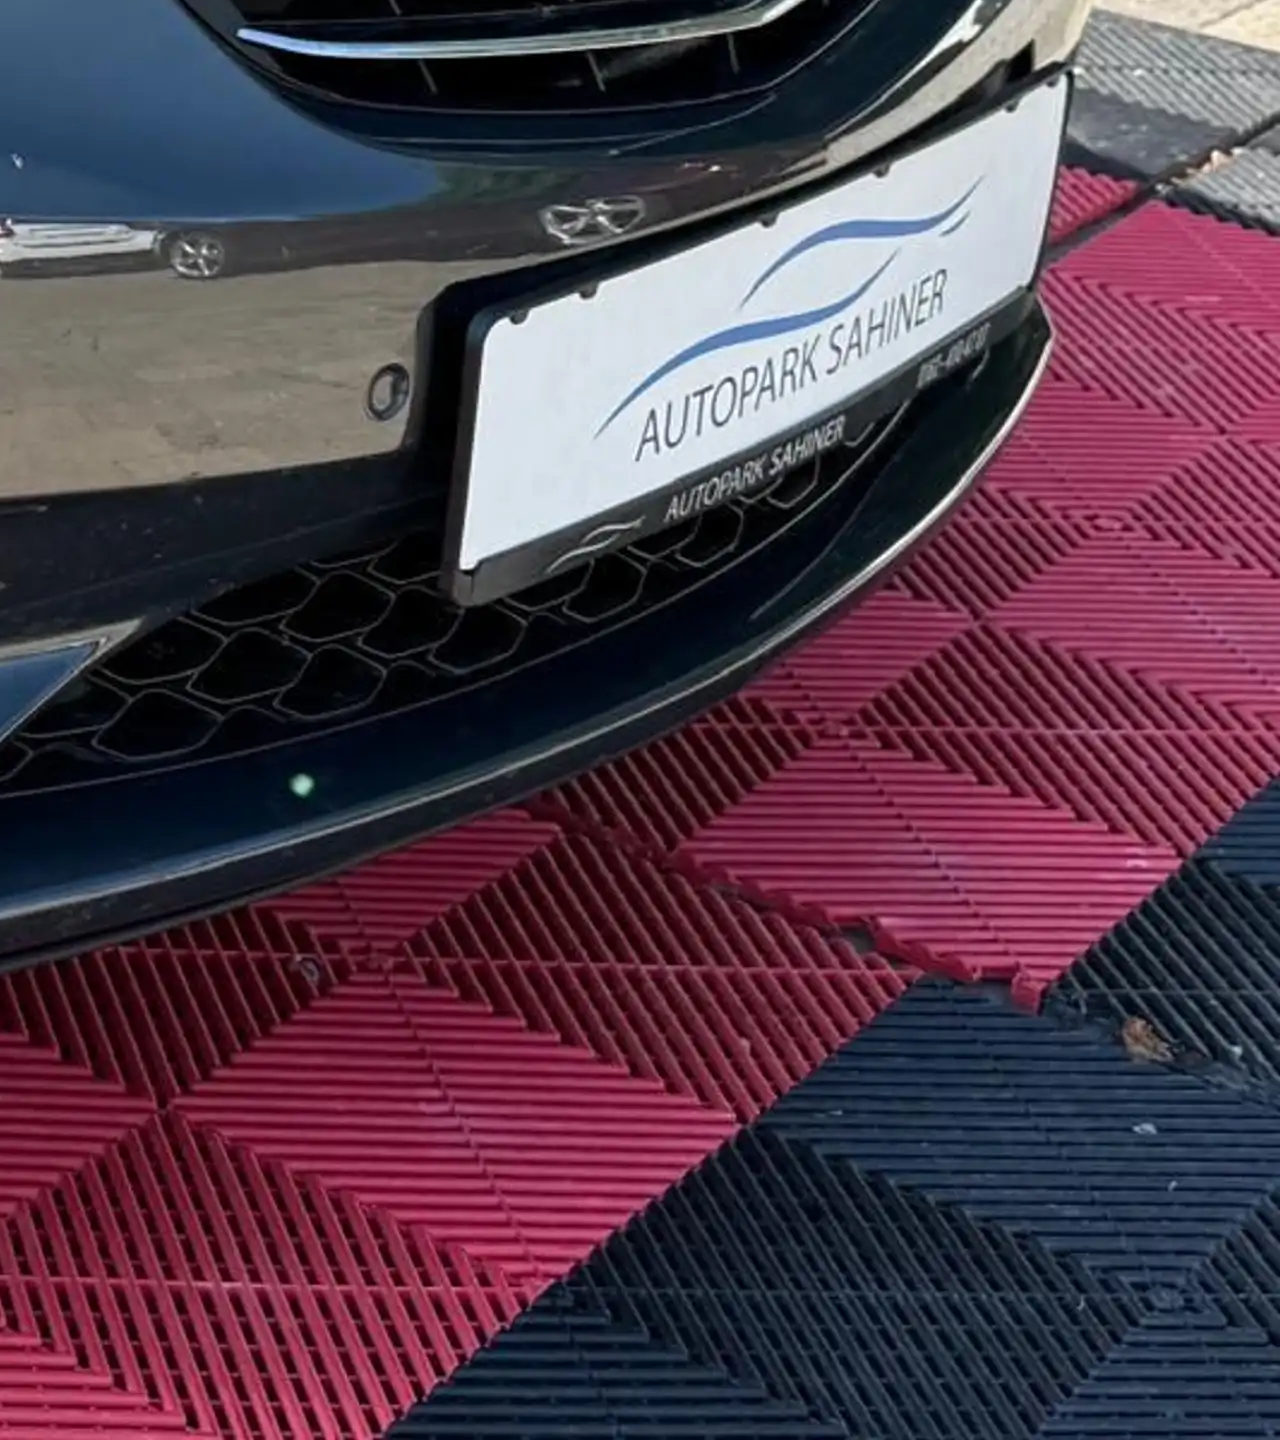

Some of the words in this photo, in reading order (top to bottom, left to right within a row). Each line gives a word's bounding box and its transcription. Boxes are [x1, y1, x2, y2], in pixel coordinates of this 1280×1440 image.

[634, 333, 821, 462] AUTOPARK
[826, 268, 948, 375] SAHINER
[663, 453, 768, 523] AUTOPARK
[768, 414, 847, 476] SAHINER
